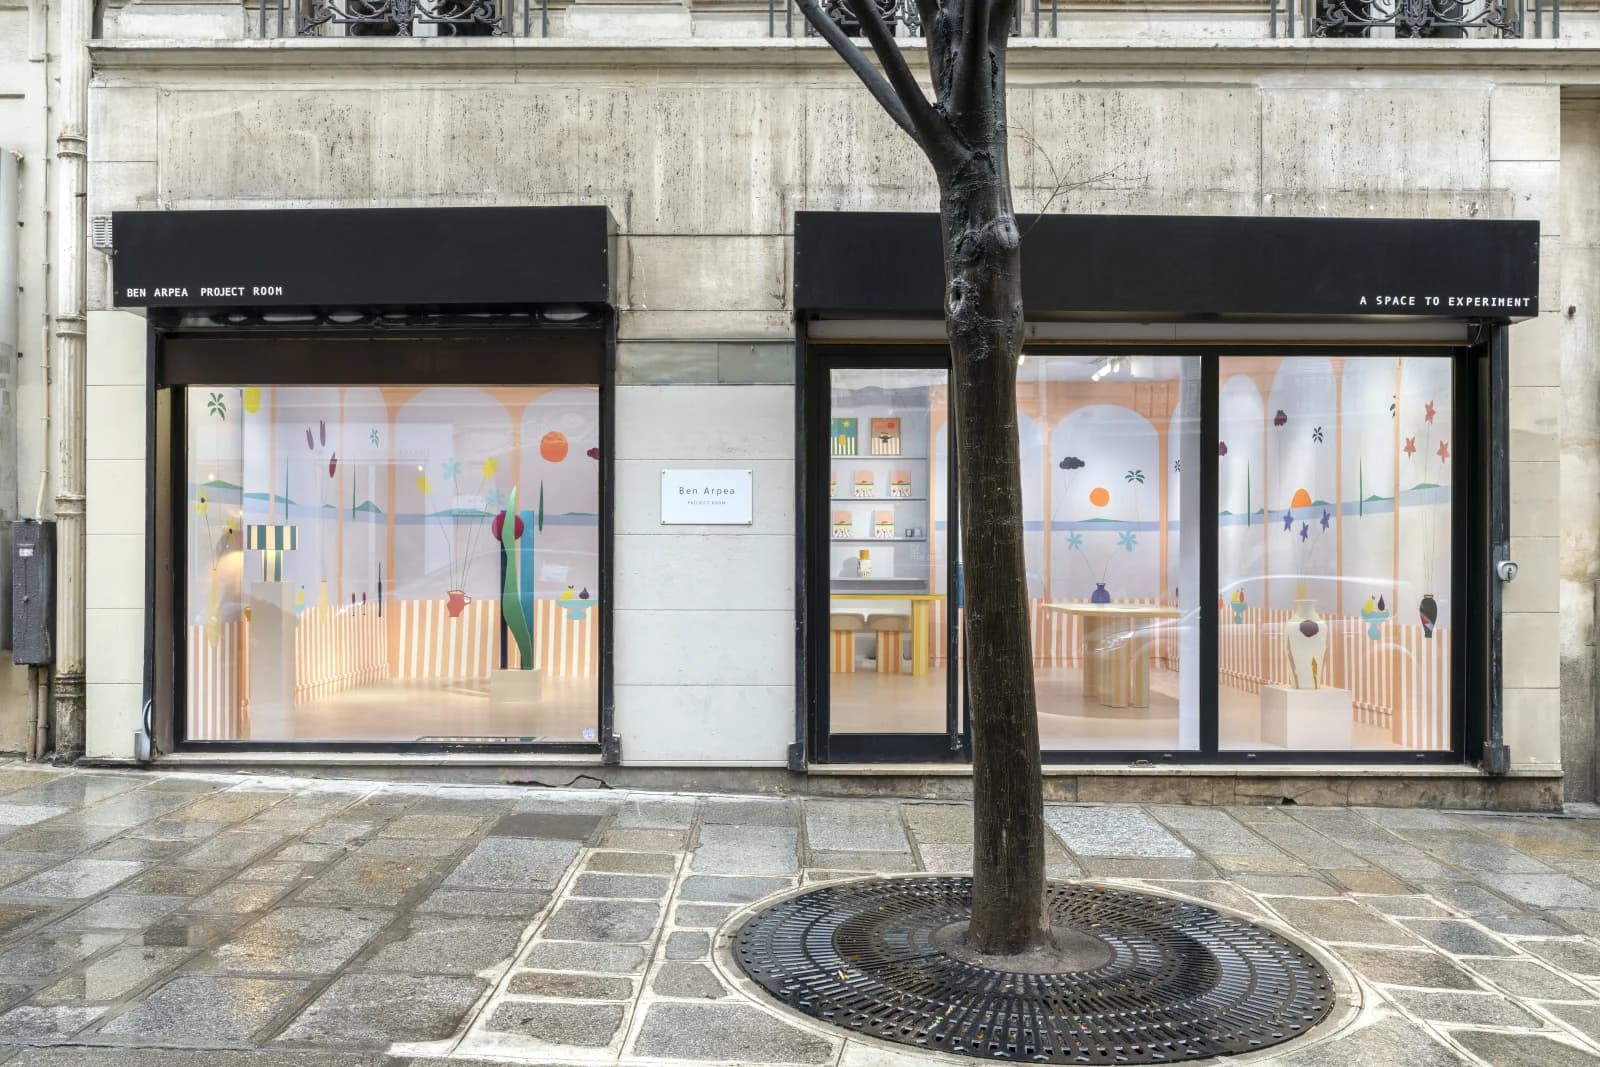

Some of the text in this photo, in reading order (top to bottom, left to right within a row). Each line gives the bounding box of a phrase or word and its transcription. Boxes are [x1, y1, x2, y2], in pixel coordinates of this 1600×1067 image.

[126, 285, 283, 298] BEN ARPEA PROJECT ROOM
[1359, 295, 1530, 307] A SPACE TO EXPERIMENT
[679, 486, 735, 497] Ben Arpea
